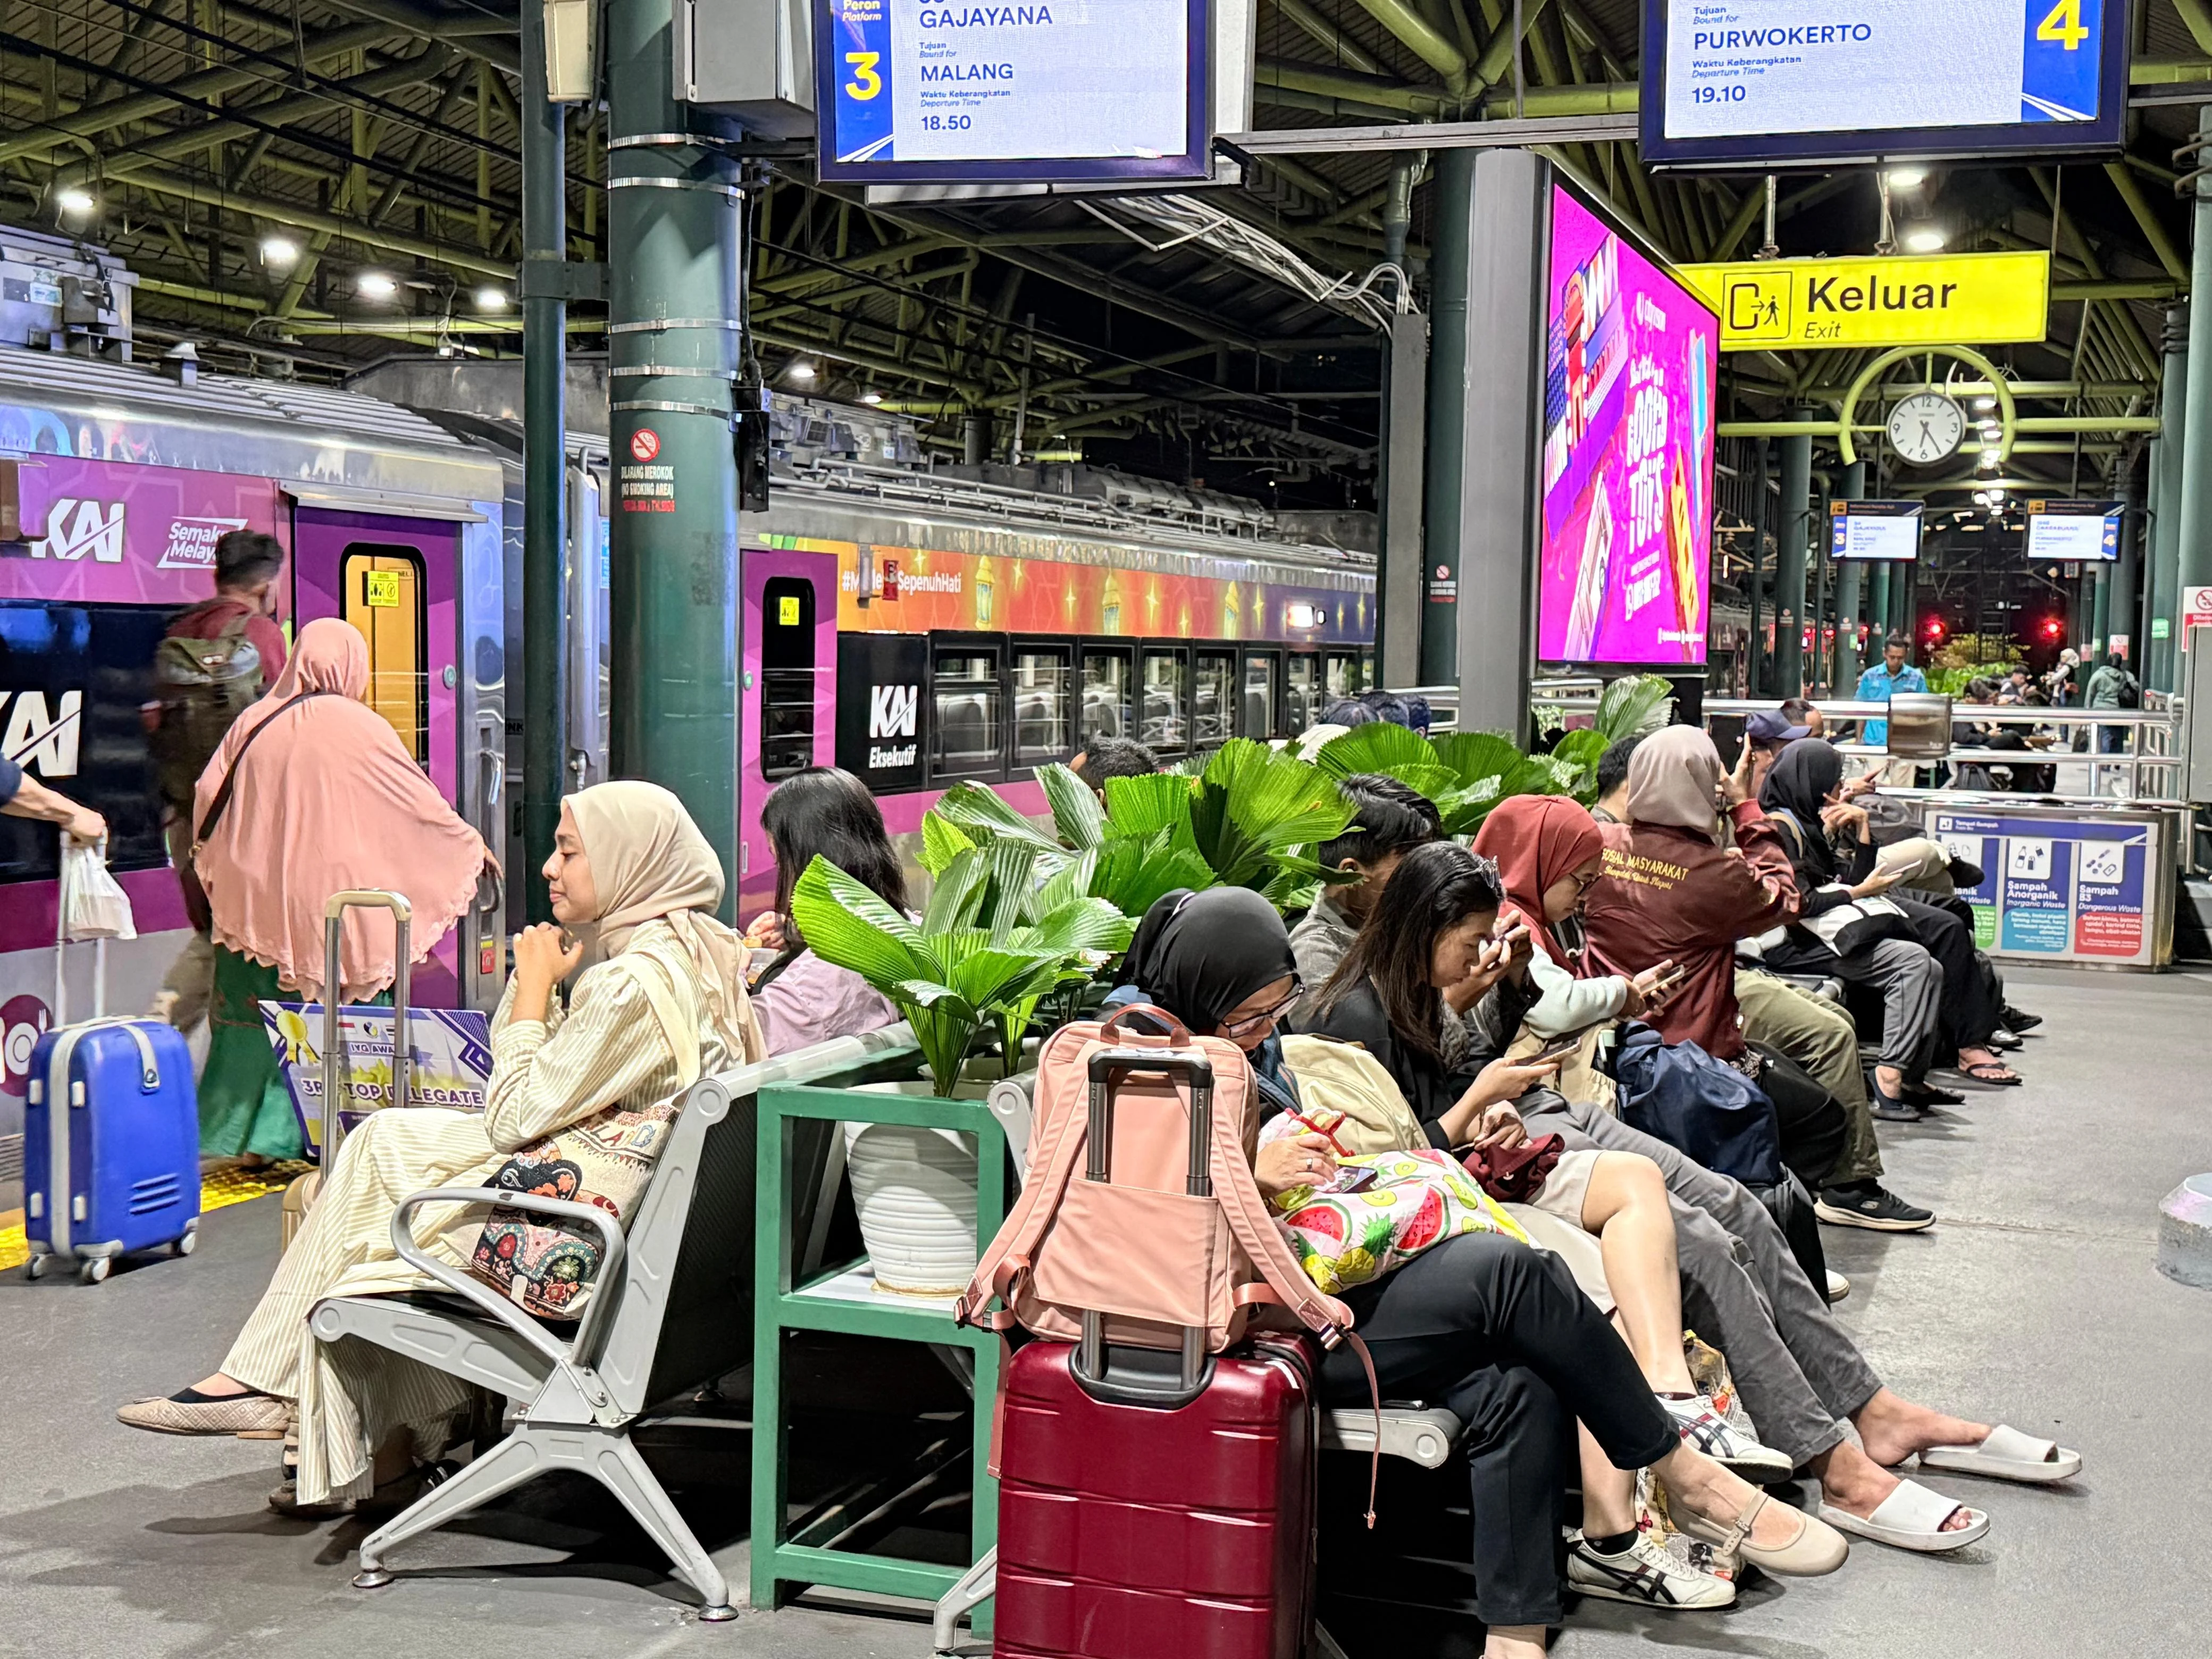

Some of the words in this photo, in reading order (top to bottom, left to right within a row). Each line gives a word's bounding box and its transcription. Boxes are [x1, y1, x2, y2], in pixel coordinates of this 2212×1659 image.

[843, 0, 881, 10] Peron
[1694, 6, 1727, 16] Tujuan
[842, 12, 882, 22] Platform
[919, 6, 1053, 28] GAJAYANA
[1693, 16, 1722, 24] Bound
[2037, 0, 2089, 50] 4
[1694, 24, 1871, 49] PURWOKERTO
[919, 41, 946, 51] Tujuan
[1692, 60, 1724, 68] Waktu
[1728, 56, 1802, 66] Keberangkatan
[845, 52, 881, 100] 3
[921, 63, 1013, 81] MALANG
[1692, 69, 1739, 79] Departure
[949, 89, 1010, 98] Keberangkatan
[1692, 85, 1746, 104] 19.10
[921, 115, 971, 130] 18.50
[1807, 274, 1957, 312] Keluar
[1804, 321, 1841, 339] Exit
[1922, 396, 1932, 407] 12
[1893, 423, 1901, 434] 9
[1951, 423, 1958, 433] 3
[1920, 449, 1928, 460] 6
[644, 465, 674, 480] MEROKOK
[630, 482, 655, 496] SMOKING
[31, 499, 124, 563] KAI
[169, 522, 228, 543] Semak
[1835, 532, 1846, 545] 3
[2104, 534, 2116, 547] 4
[170, 540, 216, 564] Melay
[870, 685, 918, 739] KAI
[0, 690, 82, 776] AI
[869, 744, 917, 769] Eksekutif
[1627, 853, 1689, 881] MASYARAKAT
[2008, 881, 2047, 891] Sampah
[2080, 884, 2118, 896] Sampah
[2007, 890, 2058, 901] Anorganik
[2079, 893, 2091, 902] B3
[2007, 899, 2041, 908] Inorganic
[2078, 902, 2117, 912] Dangerous
[2118, 904, 2141, 913] Waste
[343, 1083, 382, 1100] TOP
[386, 1084, 485, 1107] LEGATE
